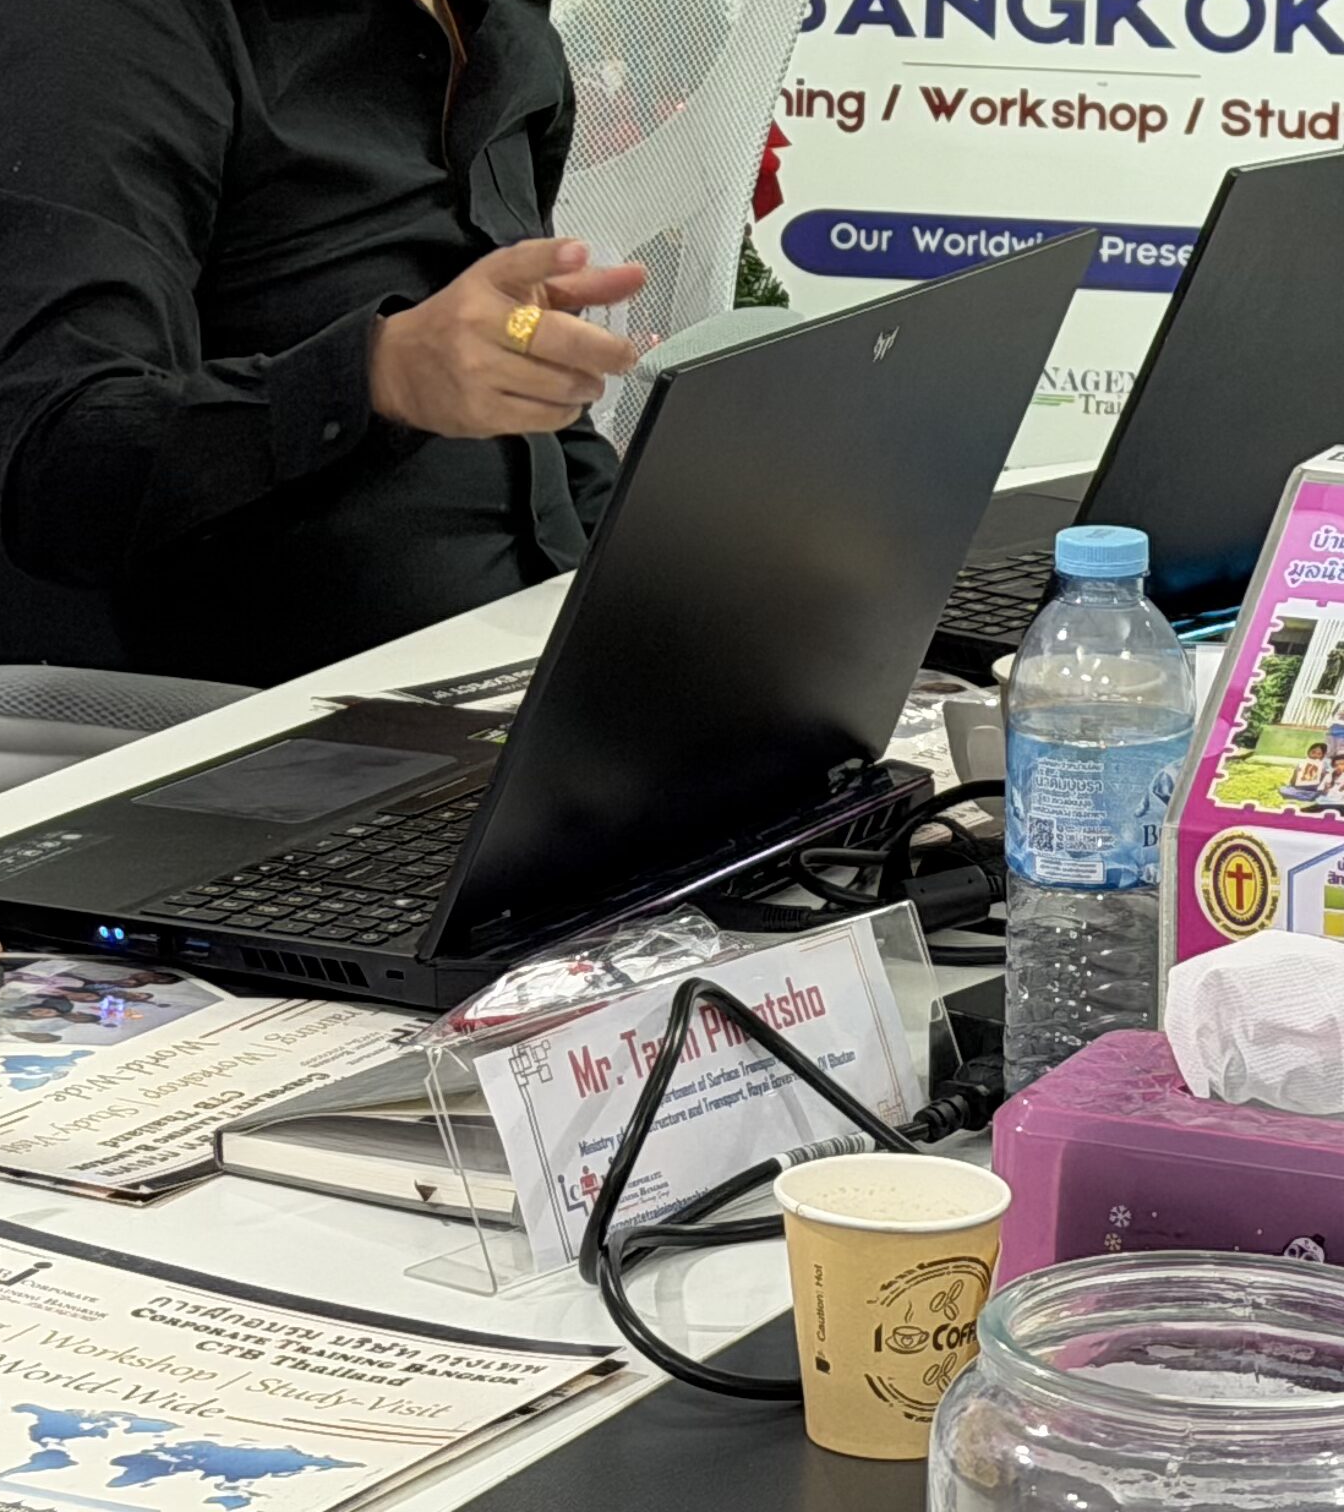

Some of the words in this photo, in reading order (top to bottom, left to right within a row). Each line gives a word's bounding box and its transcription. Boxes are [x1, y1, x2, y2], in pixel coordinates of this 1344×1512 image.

[920, 86, 1168, 143] Workshop
[830, 221, 893, 254] Our
[567, 1045, 625, 1099] Mr.
[129, 1307, 273, 1346] CORPORATE
[275, 1338, 398, 1372] TRAINING
[397, 1360, 525, 1387] BANGKOK
[194, 1339, 264, 1363] CTB
[269, 1353, 413, 1388] Thailand
[38, 1329, 219, 1384] Workshop
[245, 1376, 453, 1421] Study-Visit
